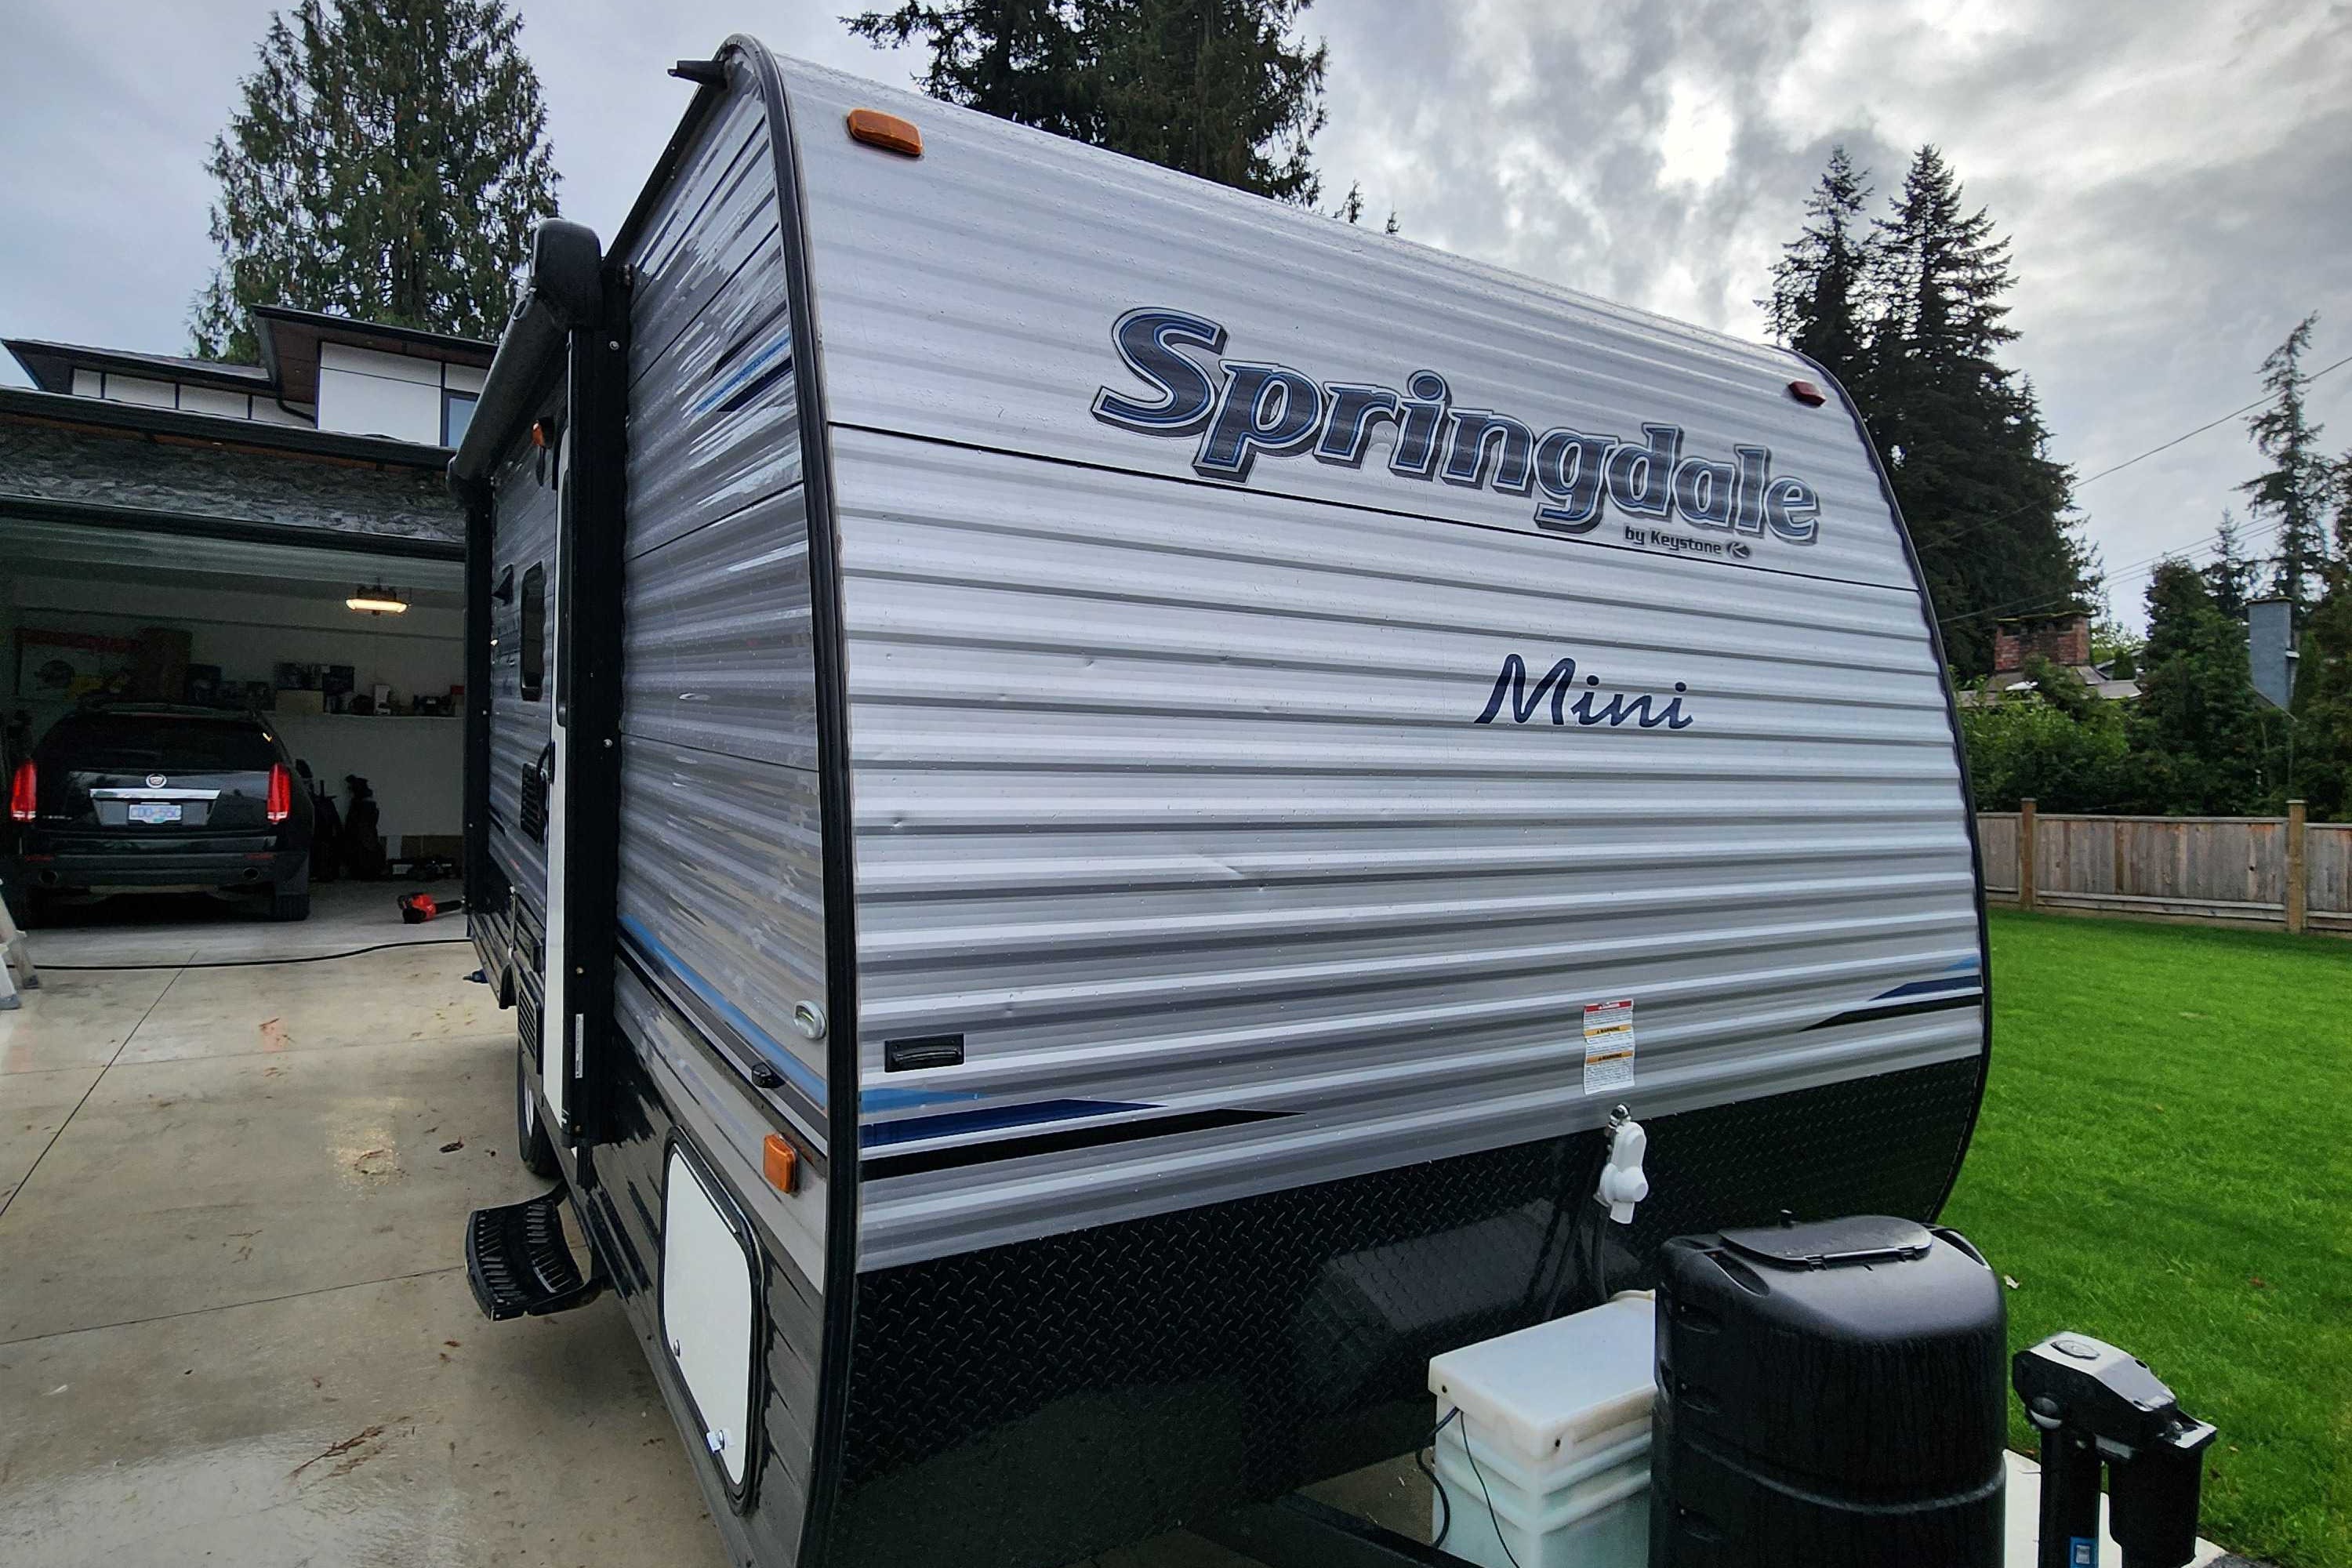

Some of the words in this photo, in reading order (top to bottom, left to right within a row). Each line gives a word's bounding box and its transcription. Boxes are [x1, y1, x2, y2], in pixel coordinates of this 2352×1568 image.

[1091, 307, 1821, 546] Springdale
[1625, 526, 1645, 545] by
[1650, 531, 1722, 554] Keystone
[1473, 653, 1693, 729] Mini
